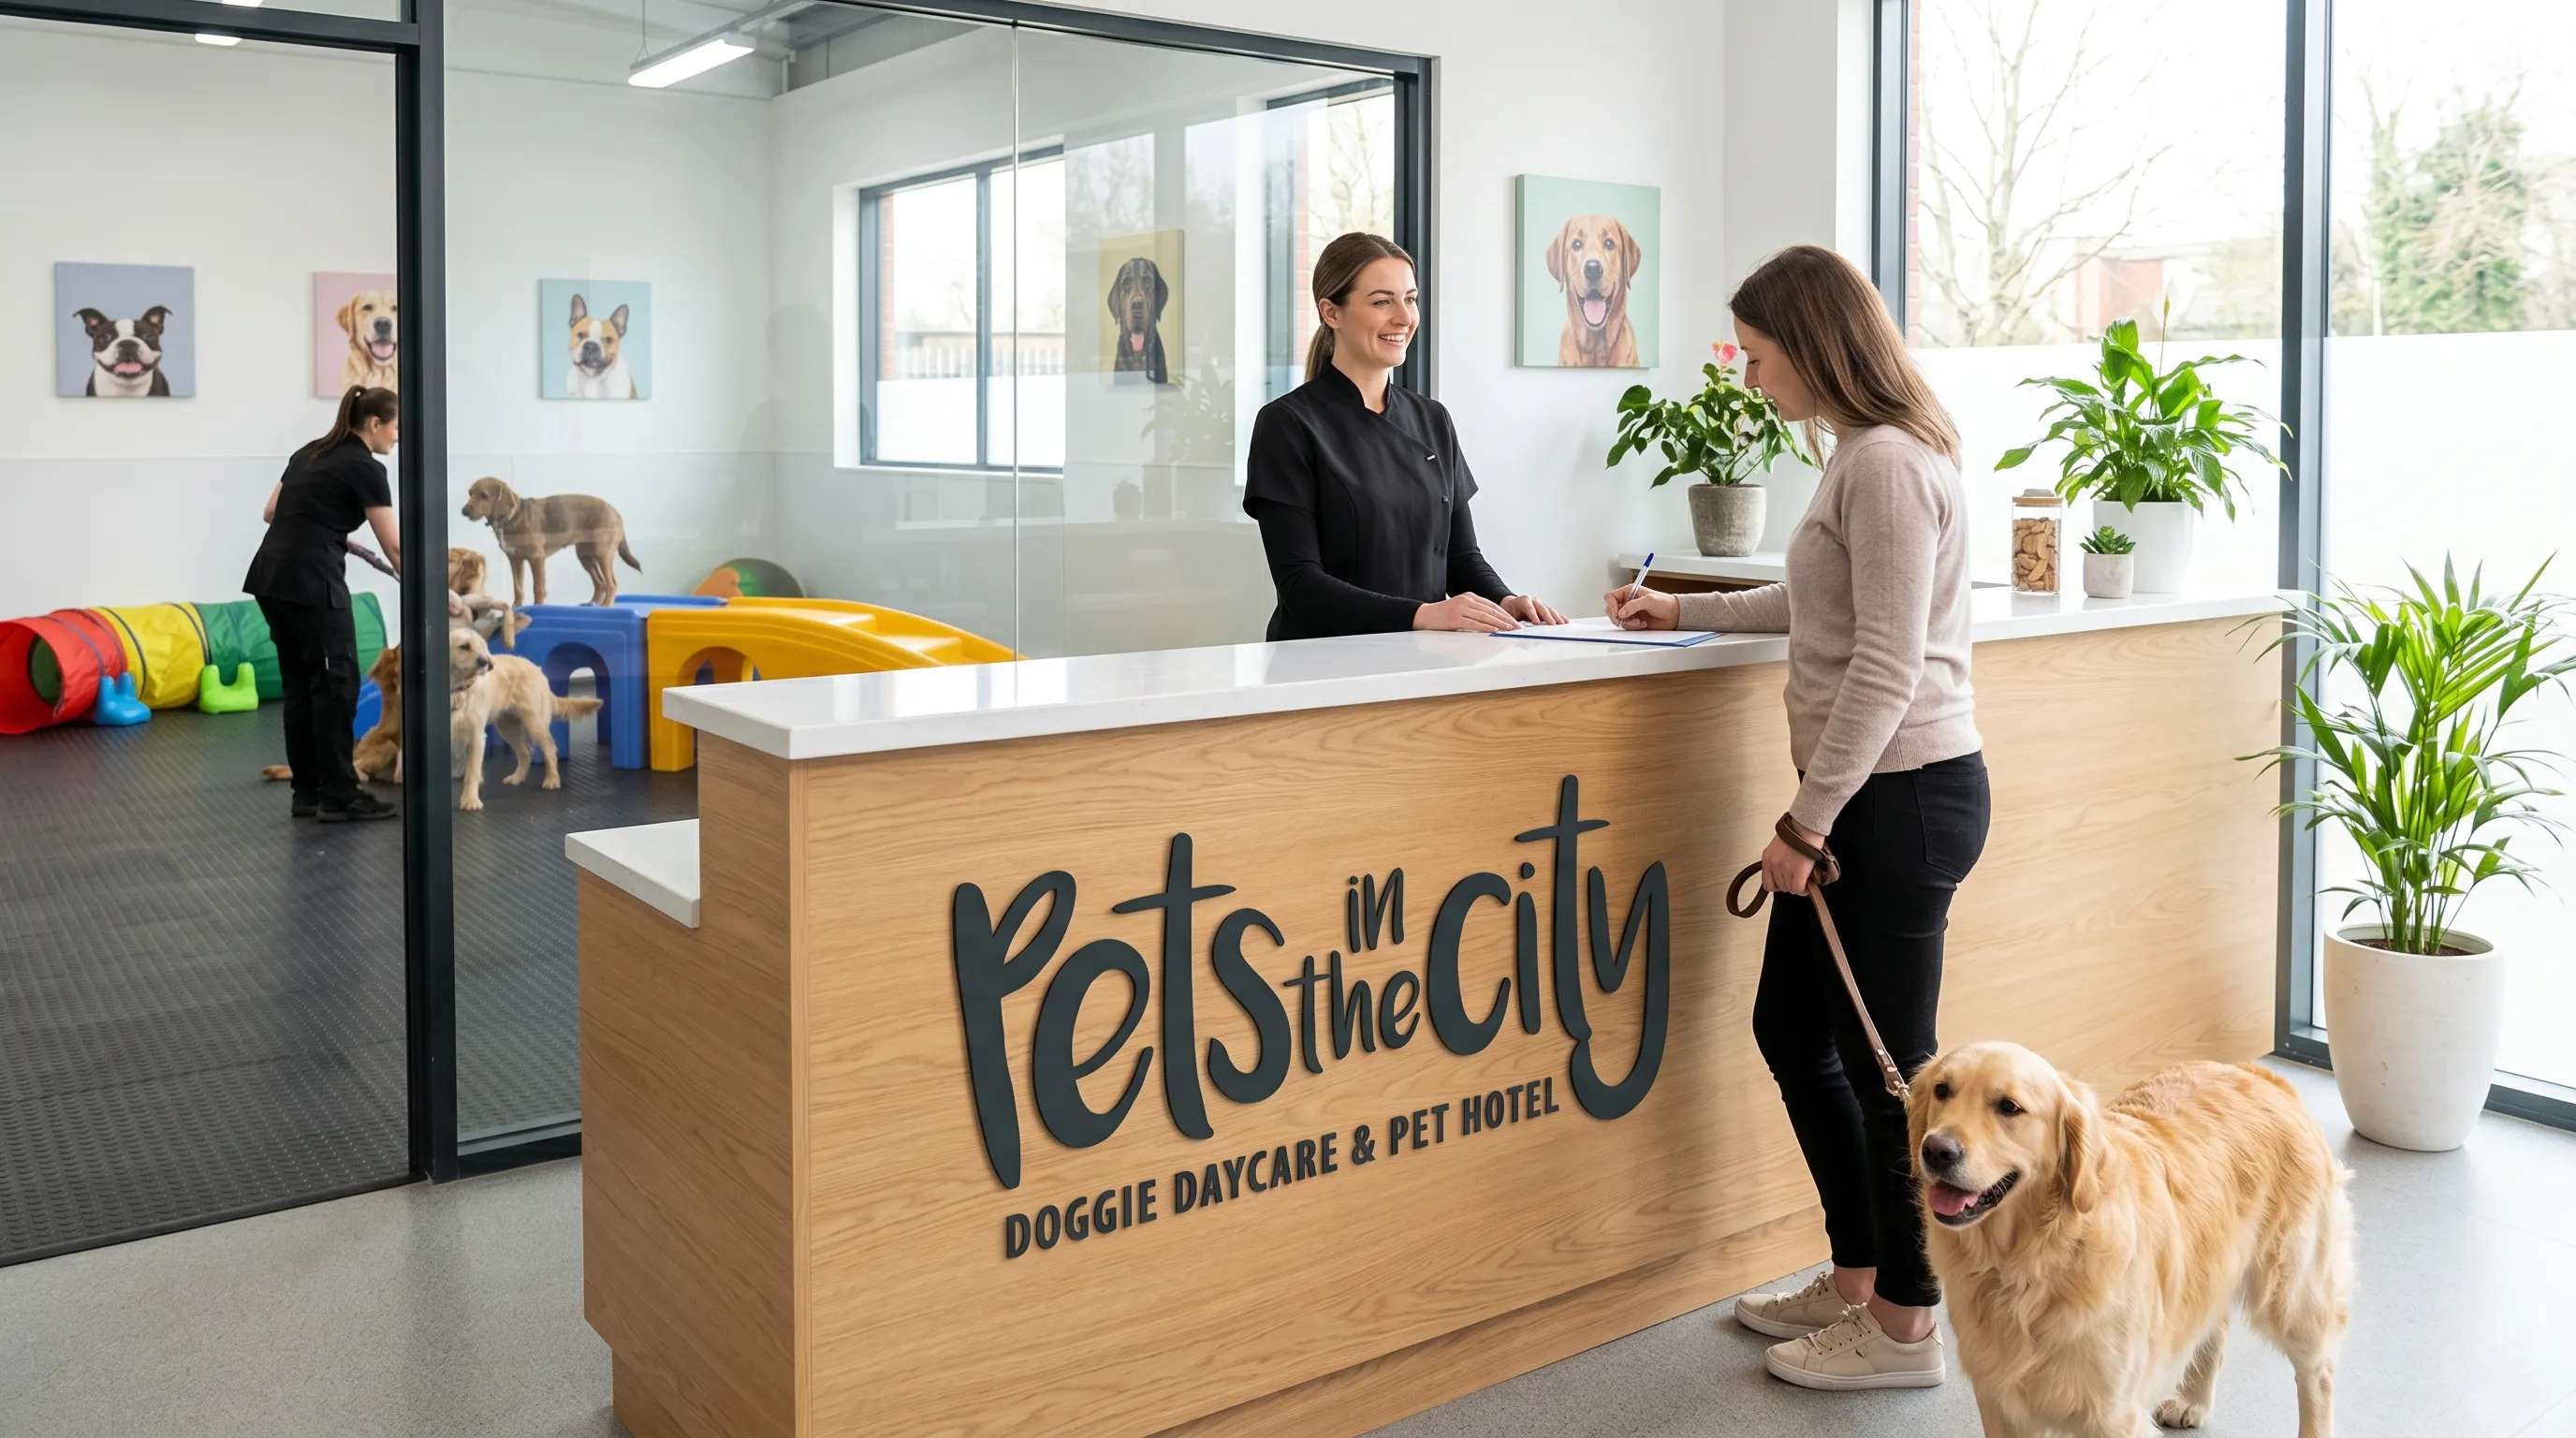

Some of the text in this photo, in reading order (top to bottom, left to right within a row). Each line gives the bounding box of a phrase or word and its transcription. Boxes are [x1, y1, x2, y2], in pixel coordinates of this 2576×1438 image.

[1347, 867, 1405, 954] in
[951, 832, 1292, 1190] Pets
[1282, 949, 1421, 1076] the
[1005, 1076, 1560, 1259] DOGGIE DAYCARE & PET HOTEL
